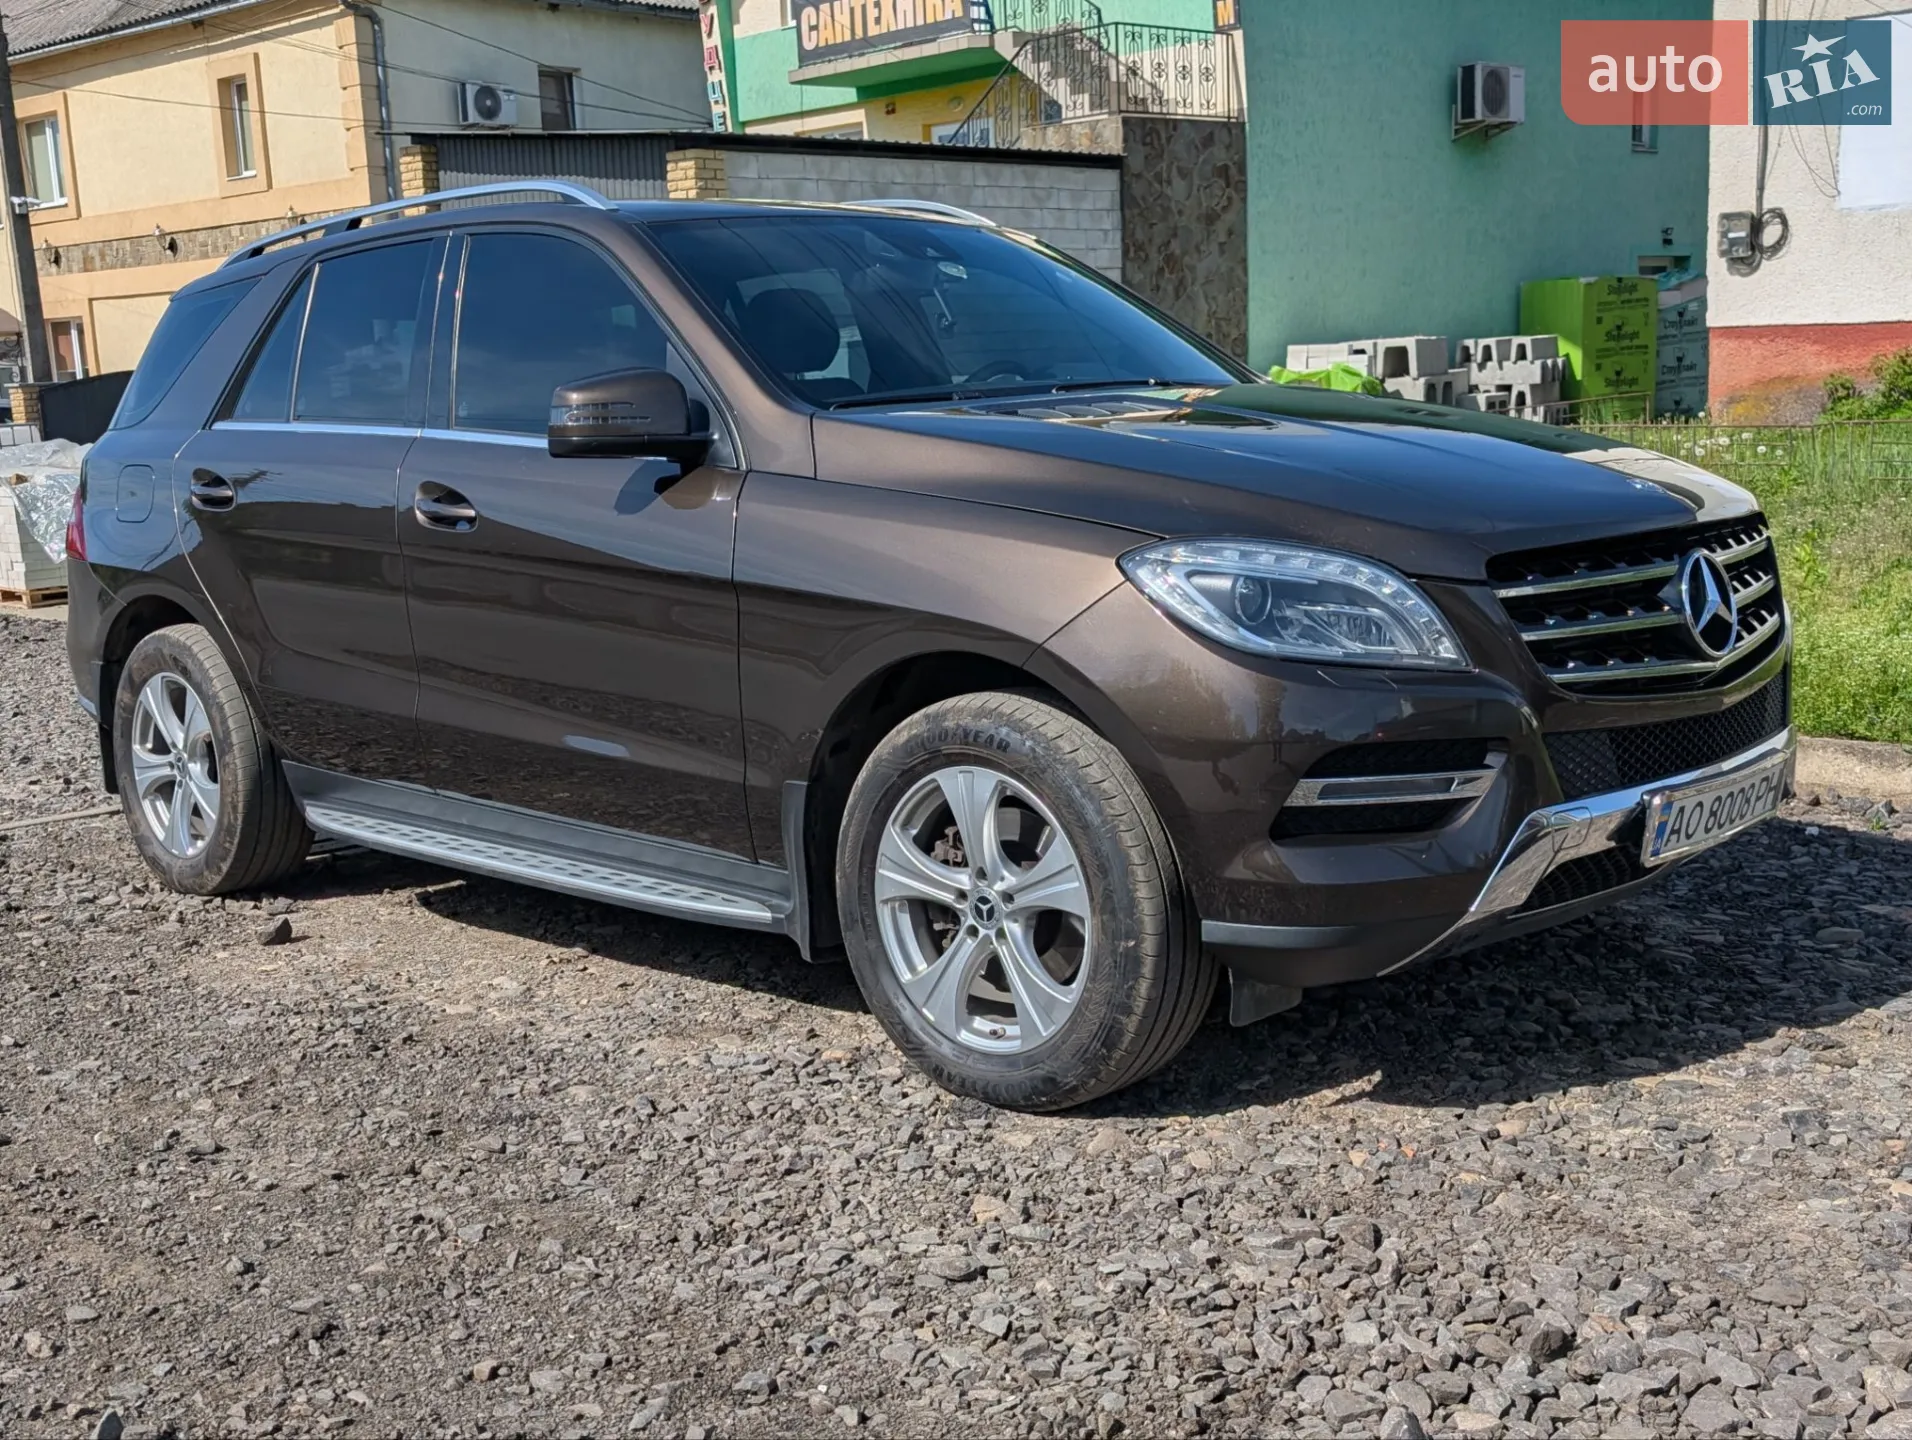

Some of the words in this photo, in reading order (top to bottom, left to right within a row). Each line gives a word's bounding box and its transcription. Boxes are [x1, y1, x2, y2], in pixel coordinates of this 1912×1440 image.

[699, 0, 726, 132] УДЦЕ
[1664, 801, 1704, 847] AO
[1704, 782, 1756, 834] 8008
